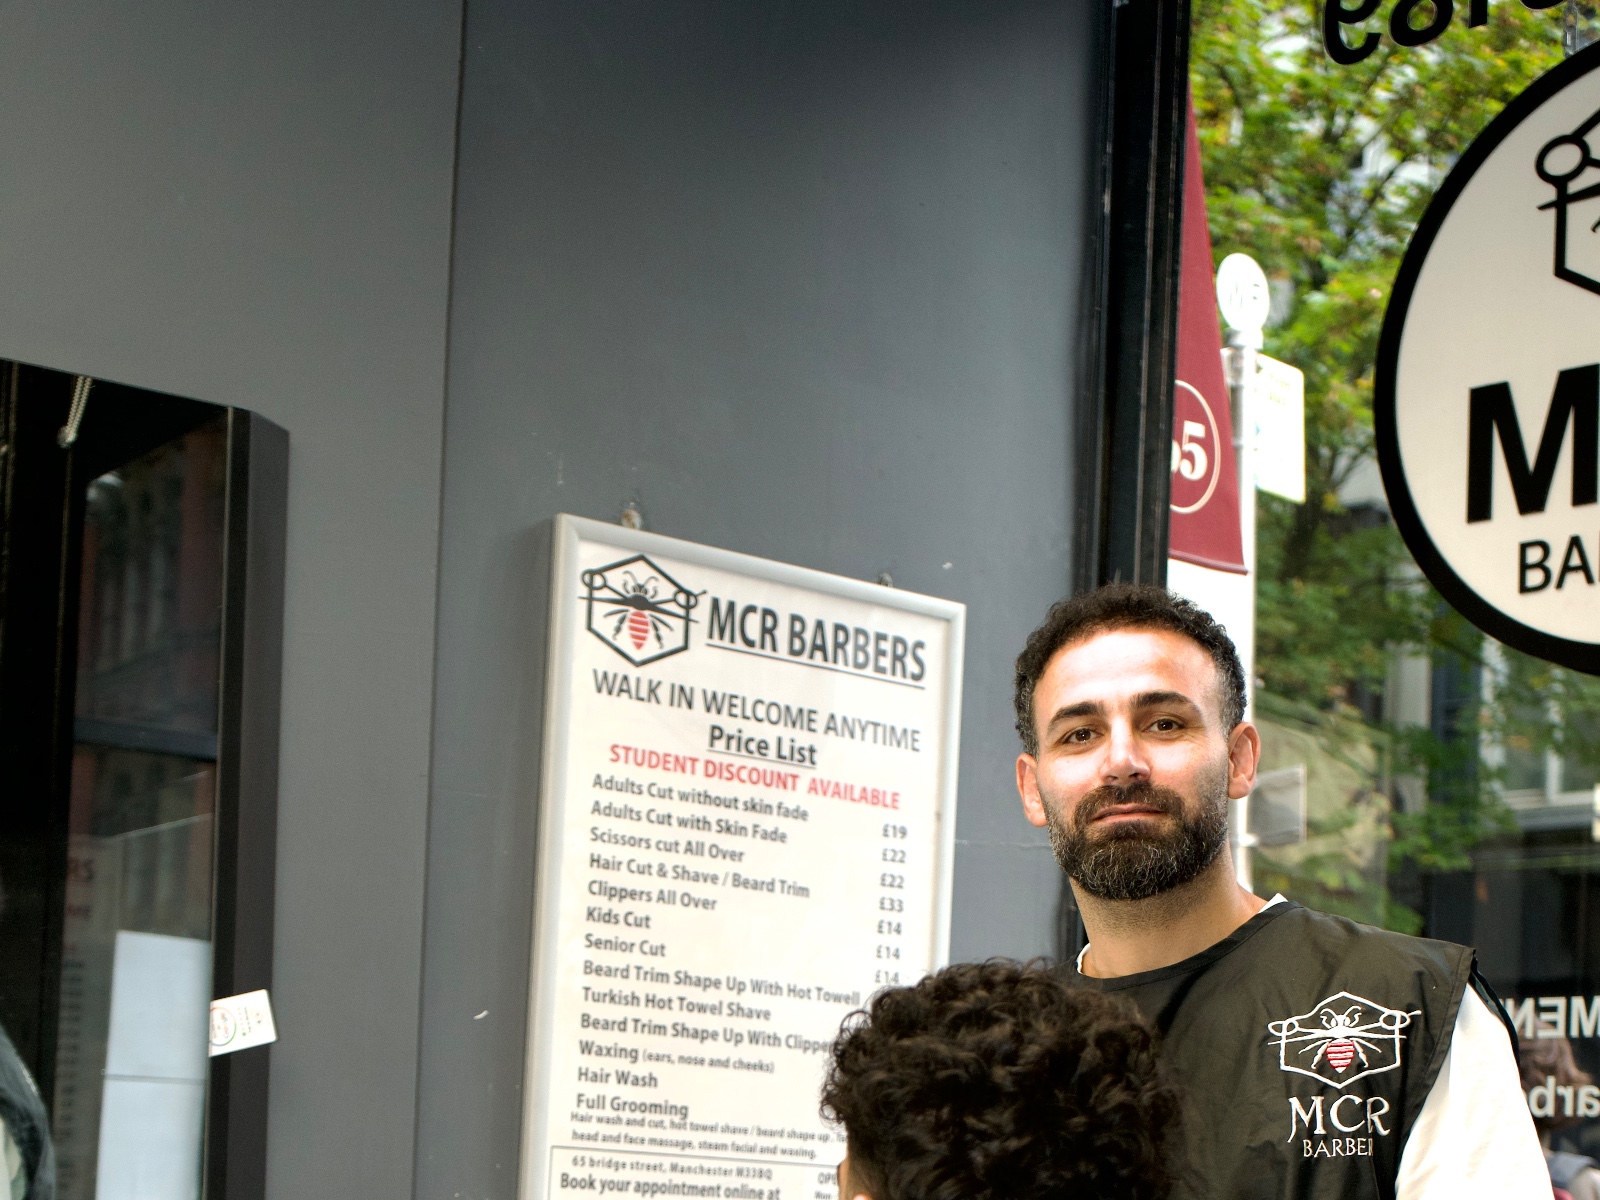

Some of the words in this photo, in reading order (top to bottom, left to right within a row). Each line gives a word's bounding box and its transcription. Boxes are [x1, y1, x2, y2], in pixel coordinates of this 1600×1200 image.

[1518, 531, 1600, 595] BA
[707, 596, 778, 652] MCR
[788, 612, 926, 682] BARBERS
[593, 668, 662, 705] WALK
[669, 682, 694, 710] IN
[702, 688, 818, 734] WELCOME
[823, 712, 921, 753] ANYTIME
[709, 725, 770, 757] Price
[776, 737, 817, 767] List
[609, 744, 699, 775] STUDENT
[704, 759, 800, 792] DISCOUNT
[807, 777, 900, 810] AVAILABLE
[592, 773, 644, 797] Adults
[647, 782, 674, 800] Cut
[677, 787, 740, 811] without
[742, 797, 774, 816] skin
[776, 802, 809, 822] fade
[591, 799, 643, 822] Adults
[646, 809, 672, 827] Cut
[676, 814, 712, 832] with
[715, 818, 748, 838] Skin
[751, 824, 788, 844] Fade
[882, 823, 908, 839] £19
[589, 827, 651, 850] Scissors
[655, 839, 680, 854] cut
[683, 839, 705, 858] All
[708, 844, 745, 864] Over
[881, 847, 906, 864] £22
[589, 853, 622, 872] Hair
[626, 859, 653, 877] Cut
[656, 863, 669, 879] &
[671, 864, 720, 886] Shave
[721, 872, 729, 887] /
[732, 872, 776, 893] Beard
[778, 879, 810, 898] Trim
[879, 872, 905, 889] £22
[588, 879, 653, 905] Clippers
[656, 888, 677, 905] All
[680, 891, 717, 910] Over
[878, 896, 904, 913] £33
[586, 906, 620, 925] Kids
[623, 911, 651, 929] Cut
[877, 919, 903, 935] £14
[585, 933, 636, 953] Senior
[639, 939, 666, 957] Cut
[875, 944, 900, 960] £14
[583, 960, 630, 980] Beard
[634, 965, 670, 984] Trim
[674, 970, 722, 992] Shape
[726, 974, 747, 995] Up
[750, 978, 784, 997] With
[787, 983, 813, 1000] Hot
[874, 969, 900, 985] £14
[582, 987, 641, 1008] Turkish
[644, 992, 674, 1011] Hot
[677, 995, 723, 1016] Towel
[726, 1000, 771, 1021] Shave
[580, 1013, 628, 1033] Beard
[631, 1018, 667, 1037] Trim
[671, 1022, 719, 1044] Shape
[723, 1028, 744, 1046] Up
[747, 1029, 782, 1049] With
[579, 1039, 639, 1063] Waxing
[642, 1049, 675, 1065] (ears,
[677, 1053, 705, 1067] nose
[708, 1056, 730, 1070] and
[732, 1058, 775, 1074] cheeks)
[578, 1066, 611, 1084] Hair
[615, 1069, 658, 1088] Wash
[576, 1093, 606, 1110] Full
[610, 1096, 689, 1120] Grooming
[1286, 1094, 1391, 1143] MCR
[570, 1111, 594, 1123] Hair
[596, 1114, 622, 1126] wash
[625, 1117, 645, 1129] and
[669, 1119, 688, 1131] hot
[690, 1121, 718, 1134] towel
[720, 1123, 749, 1136] shave
[756, 1126, 784, 1139] beard
[787, 1129, 816, 1142] shape
[571, 1129, 599, 1142] head
[601, 1132, 621, 1144] and
[623, 1133, 645, 1146] face
[648, 1136, 696, 1151] massage,
[698, 1139, 729, 1152] steam
[731, 1141, 756, 1154] facial
[758, 1144, 778, 1156] and
[589, 1156, 627, 1172] bridge
[669, 1162, 733, 1177] Manchester
[560, 1173, 597, 1190] Book
[599, 1177, 631, 1194] your
[634, 1179, 721, 1198] appointment
[723, 1183, 765, 1200] online
